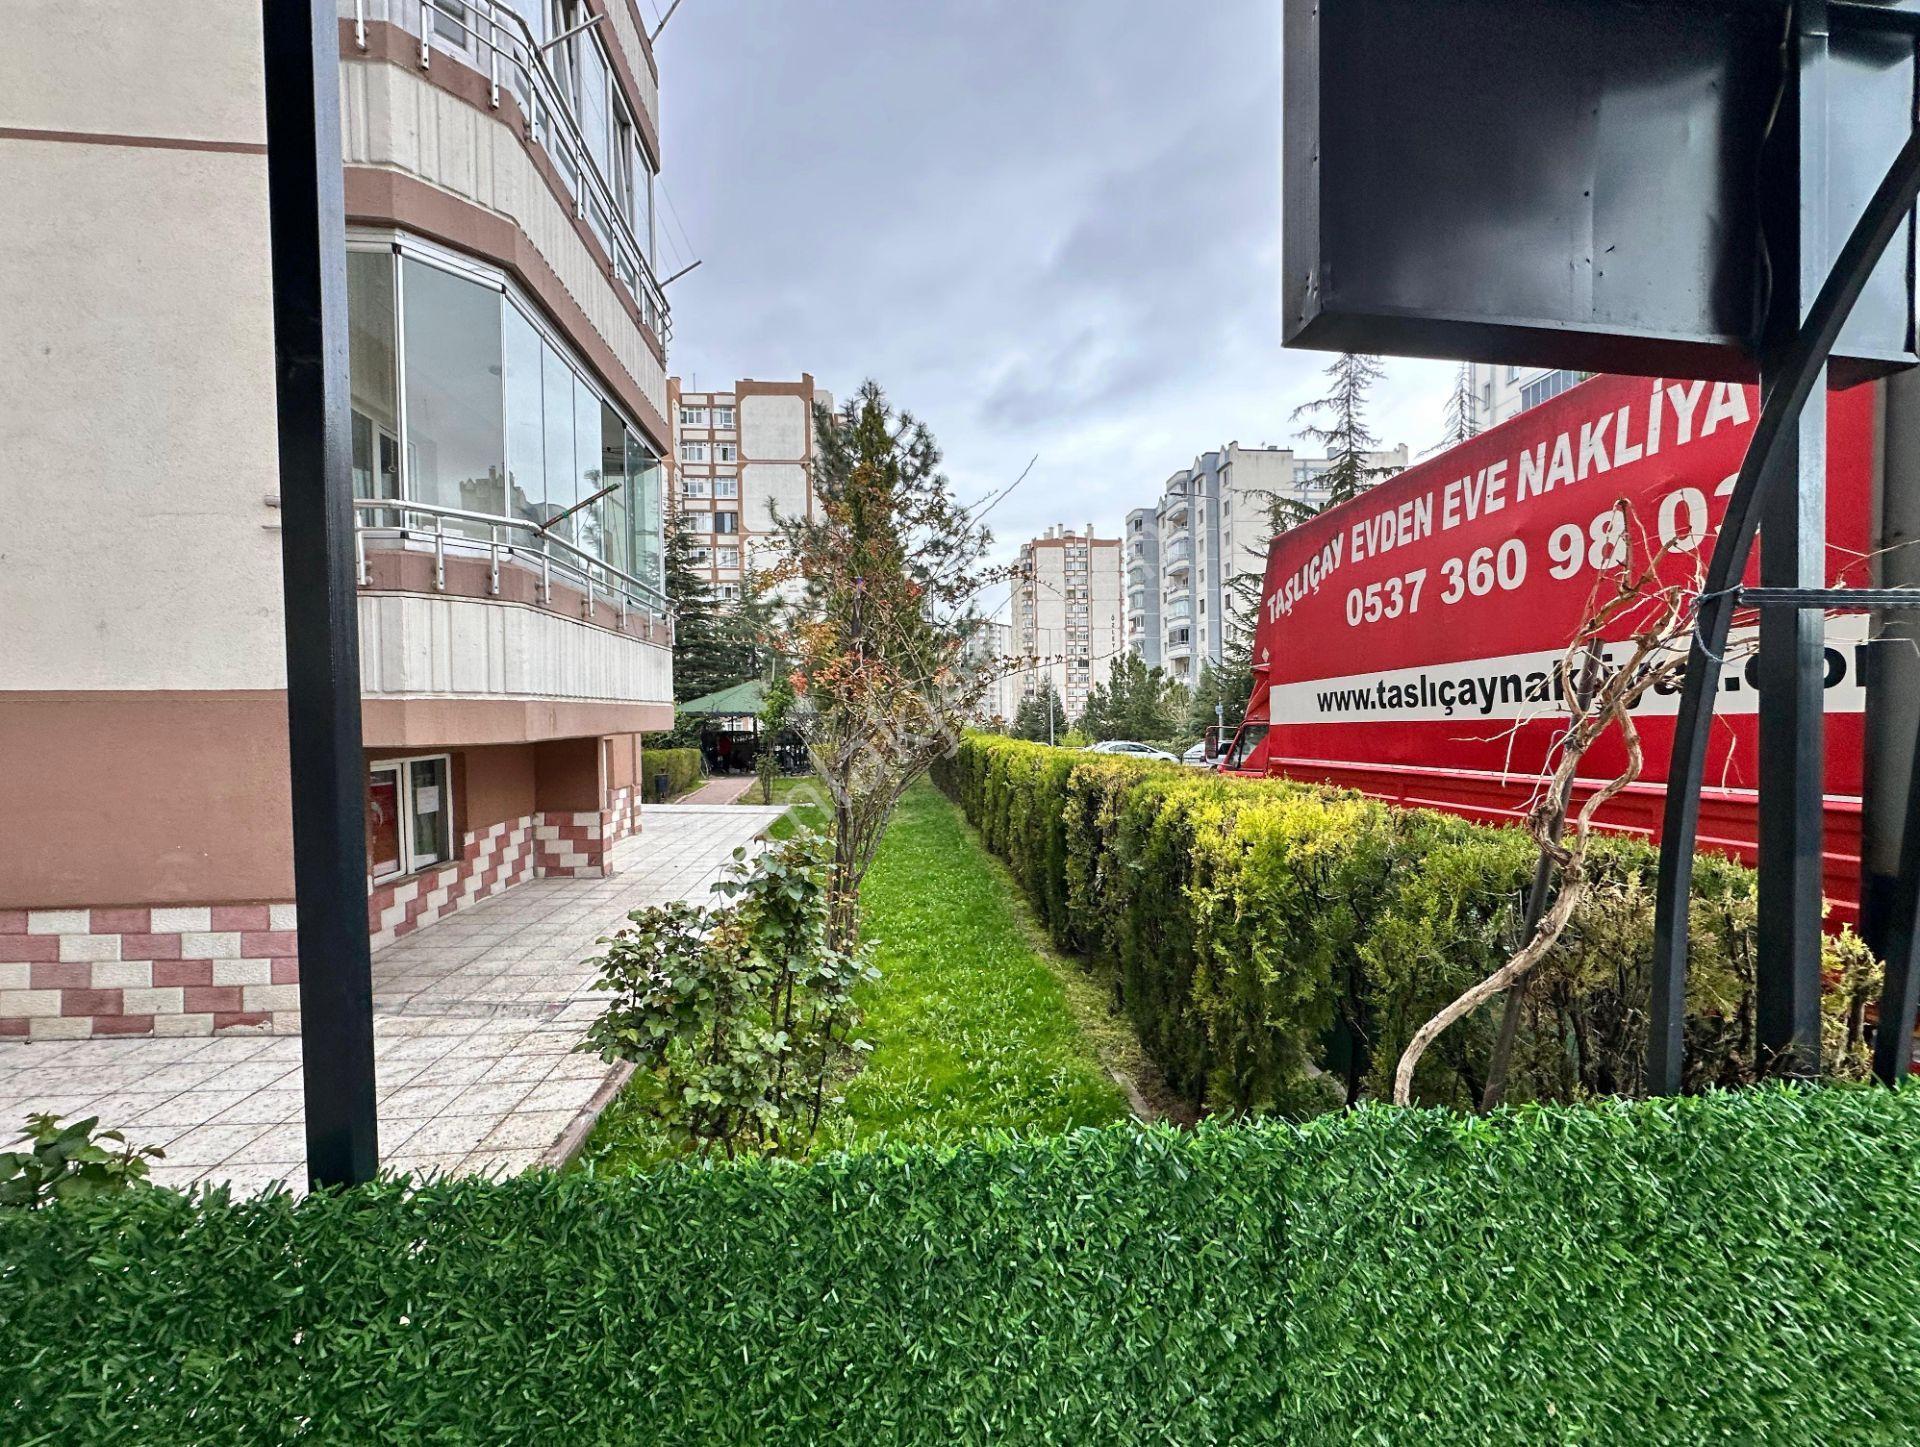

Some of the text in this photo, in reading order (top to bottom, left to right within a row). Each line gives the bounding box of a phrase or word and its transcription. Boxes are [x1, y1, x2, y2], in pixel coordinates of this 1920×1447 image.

[1267, 531, 1344, 624] TAŞLIÇAY
[1351, 492, 1433, 563] EVDEN
[1442, 459, 1508, 531] EVE
[1346, 472, 1761, 627] 0537 360 98 0
